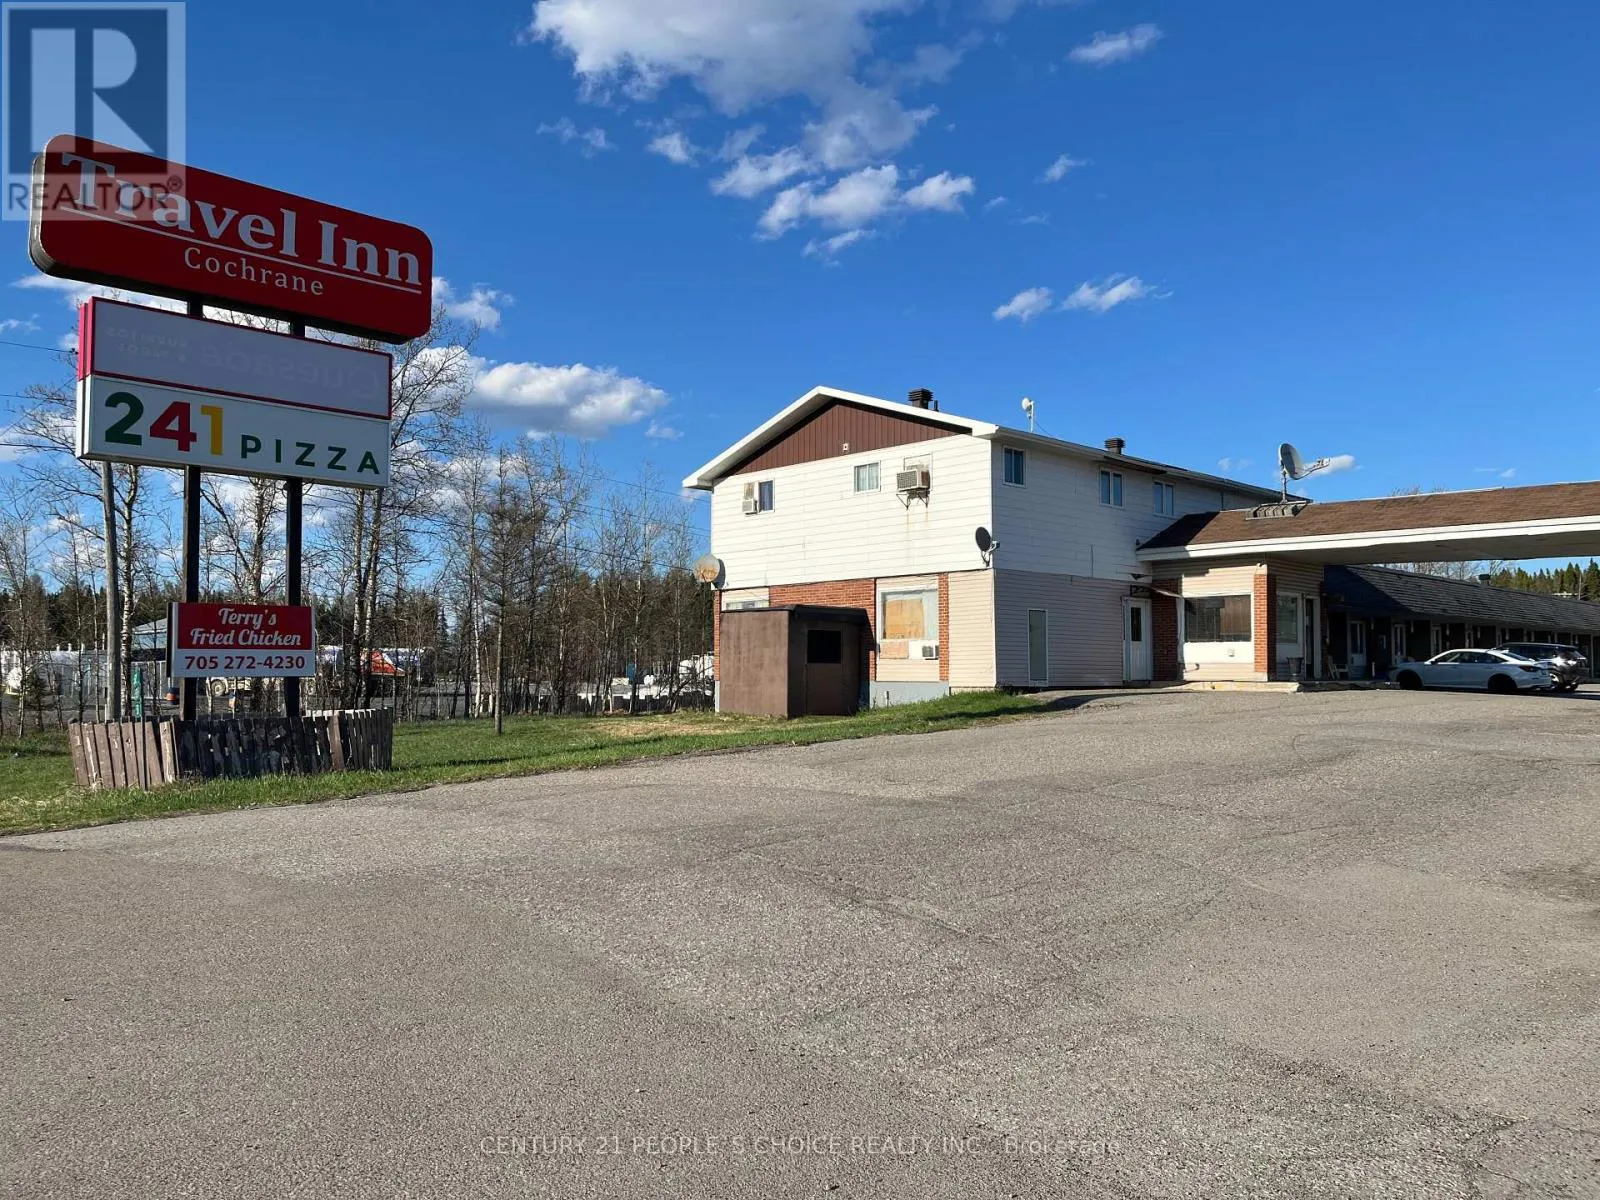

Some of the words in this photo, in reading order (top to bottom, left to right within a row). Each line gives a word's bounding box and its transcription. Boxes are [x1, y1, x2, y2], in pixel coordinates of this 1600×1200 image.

[60, 152, 299, 258] Travel
[317, 220, 422, 286] Inn
[184, 246, 324, 296] Cochrane
[104, 391, 224, 456] 241
[240, 434, 381, 475] PIZZA
[190, 627, 236, 645] Fried
[237, 628, 302, 646] Chicken
[218, 607, 277, 630] Terry's
[184, 655, 219, 670] 705
[223, 655, 305, 670] 272-4230
